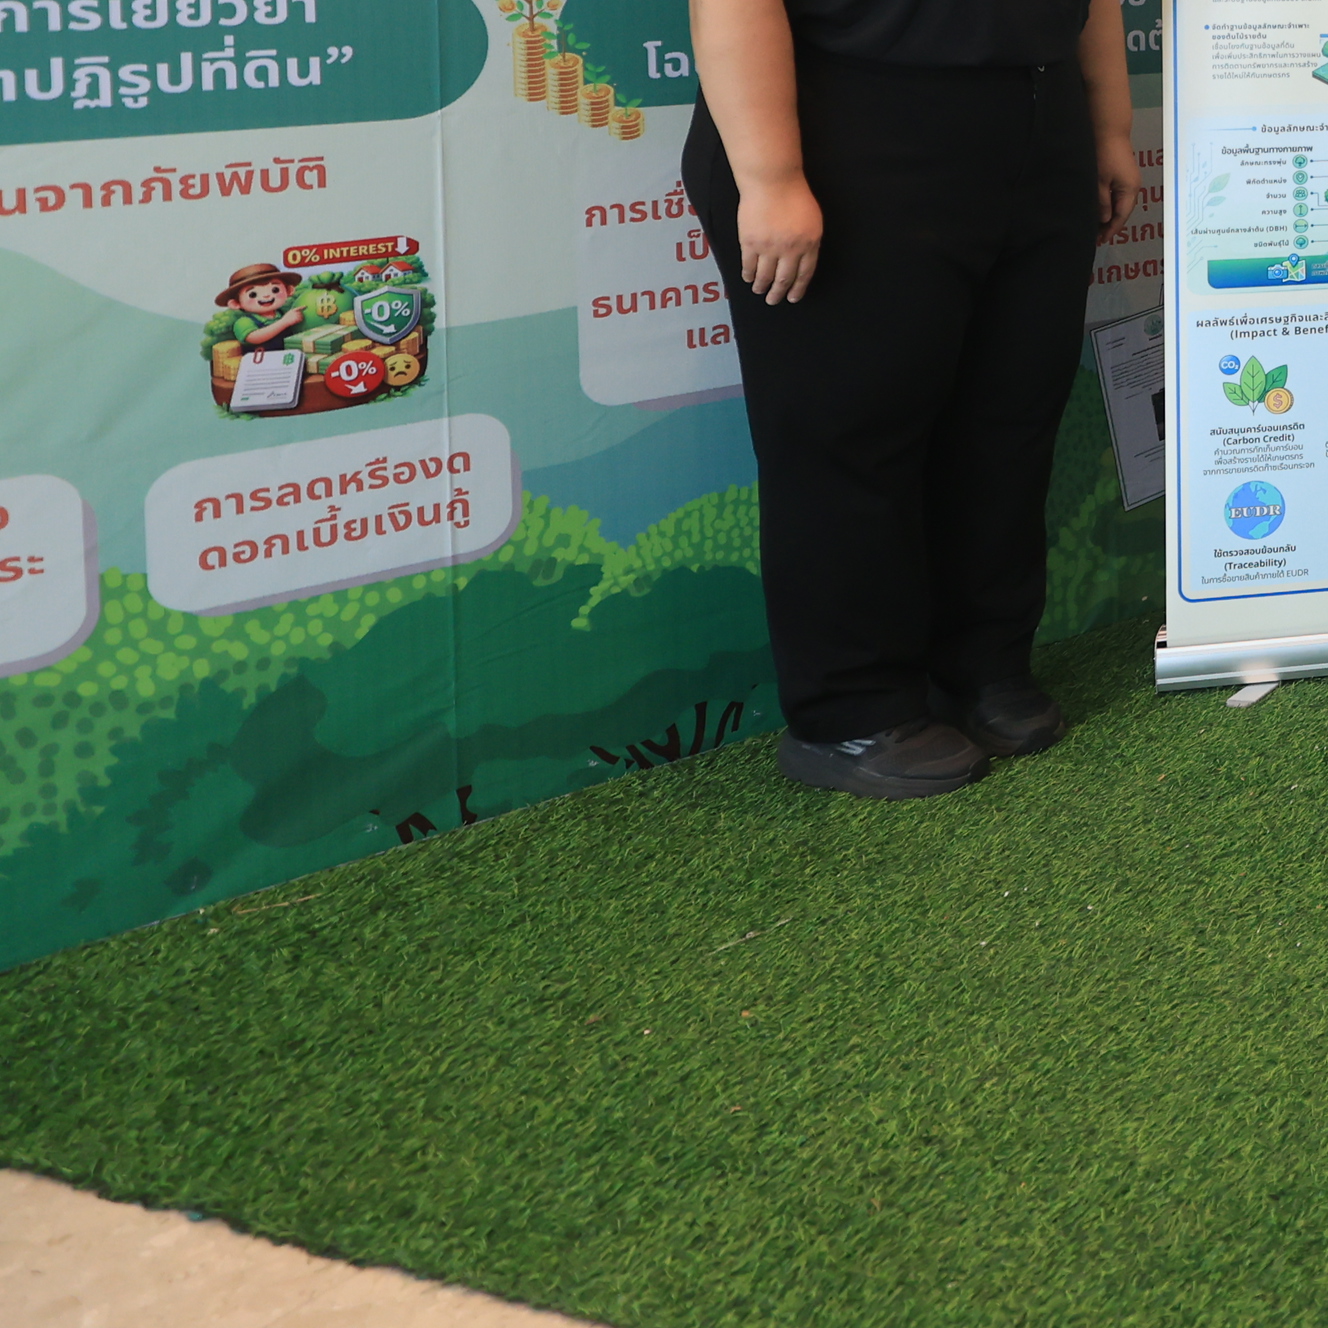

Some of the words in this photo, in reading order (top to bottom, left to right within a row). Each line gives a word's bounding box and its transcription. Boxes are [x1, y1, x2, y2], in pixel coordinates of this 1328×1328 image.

[287, 248, 321, 265] 0%
[323, 242, 394, 260] INTEREST
[1229, 326, 1278, 341] (Impact
[1282, 326, 1291, 336] &
[1222, 436, 1261, 447] (Carbon
[1262, 433, 1295, 444] Credit)
[192, 448, 473, 524] การลดหรืองด
[1229, 504, 1282, 519] EUDR
[198, 494, 471, 573] ดอกเบี้ยเงินกู้
[1224, 558, 1287, 572] (Traceability)
[1286, 568, 1309, 578] EUDR
